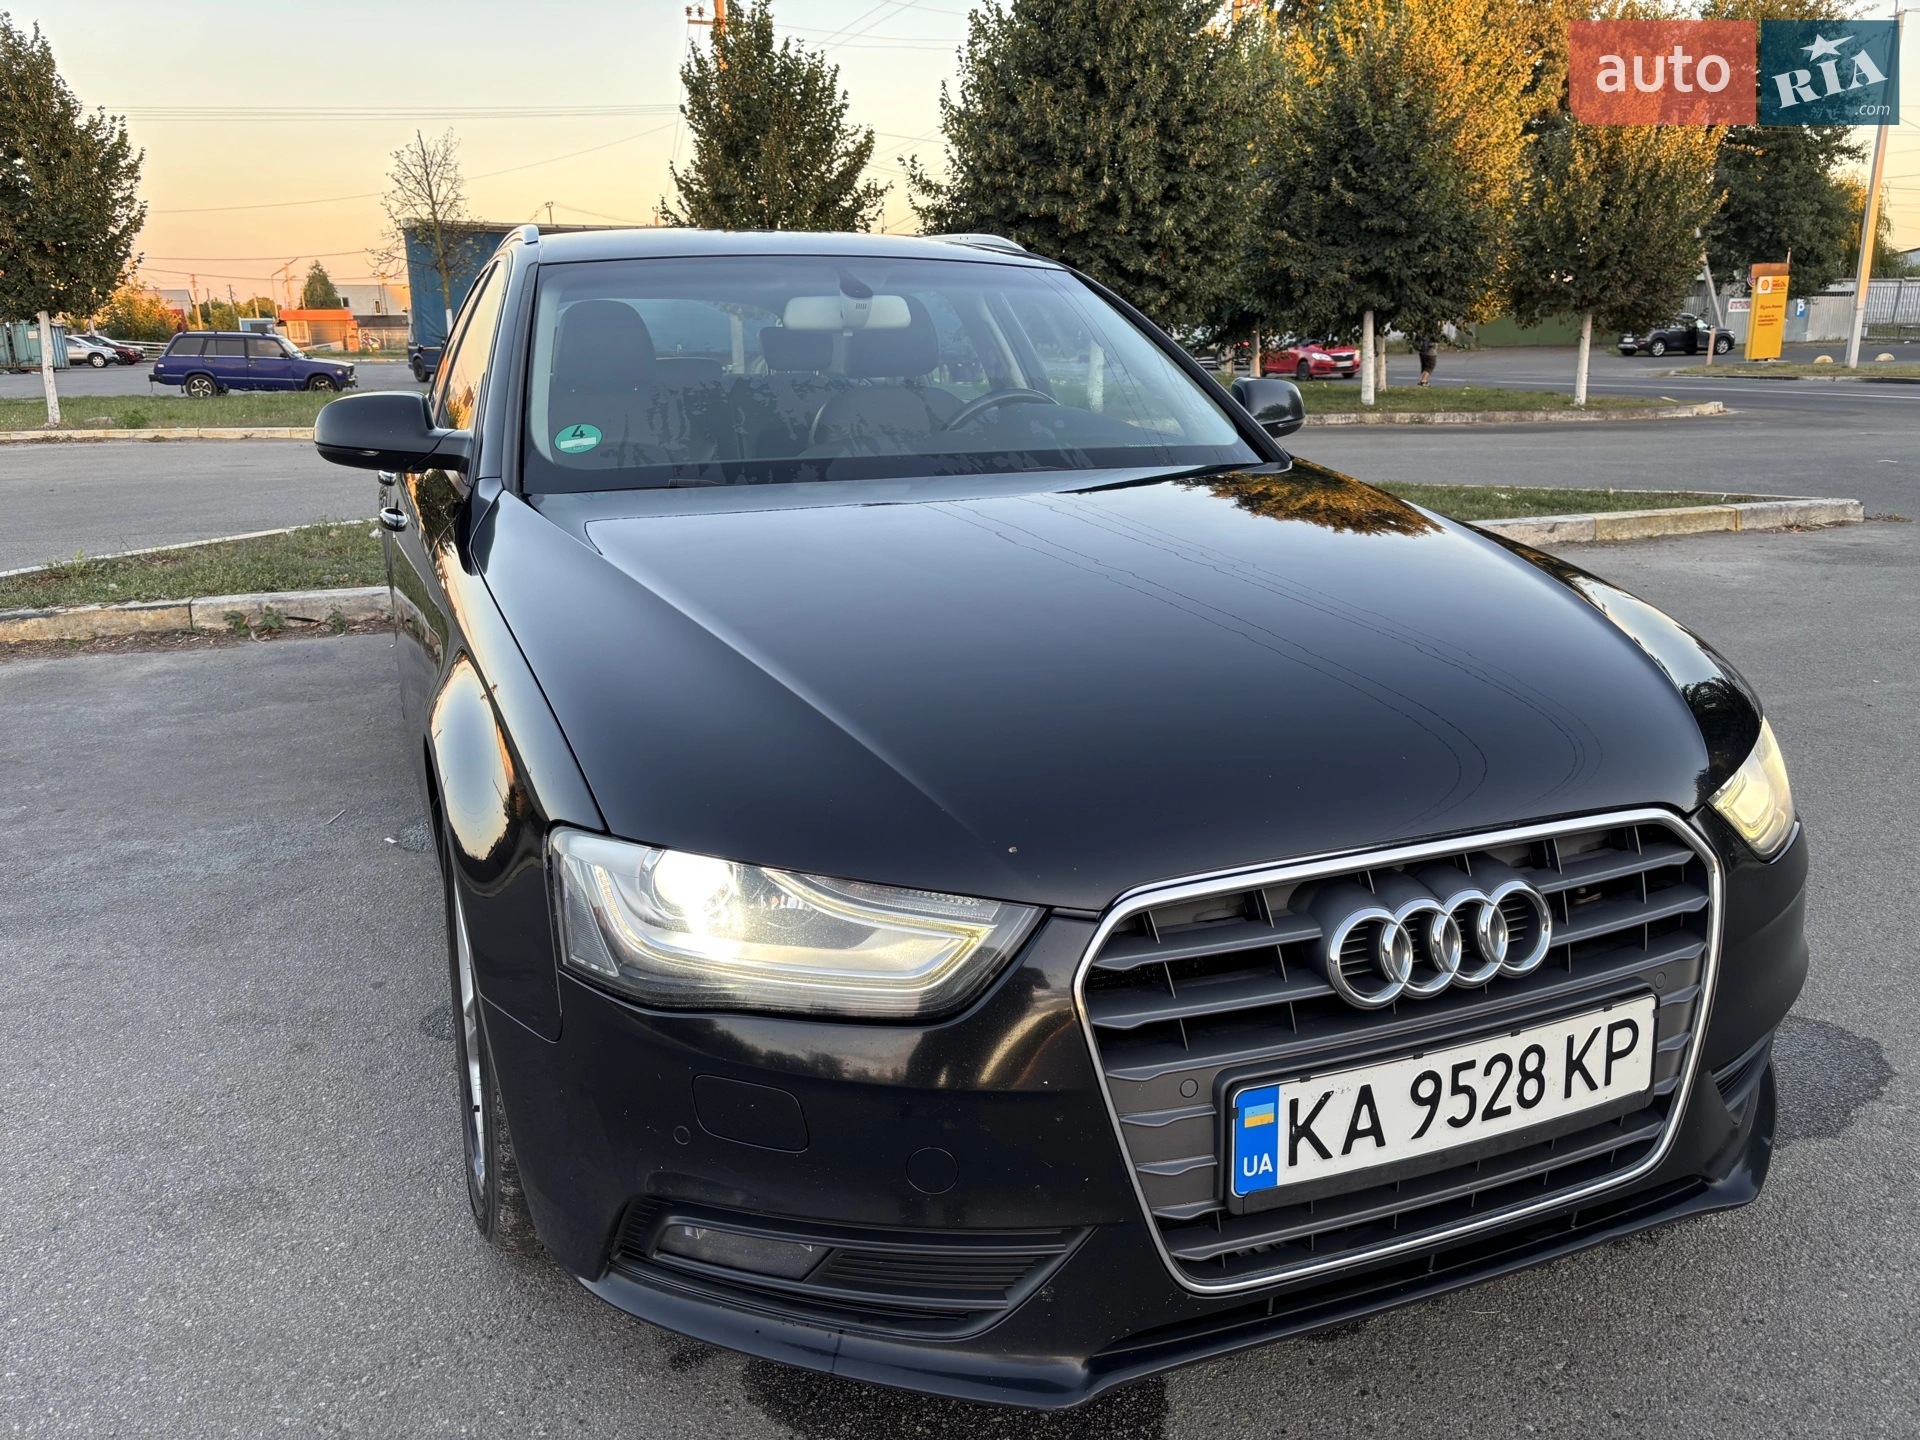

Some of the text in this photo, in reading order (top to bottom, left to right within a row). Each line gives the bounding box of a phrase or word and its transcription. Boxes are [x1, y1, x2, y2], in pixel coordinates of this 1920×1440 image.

[571, 425, 585, 438] 4
[1288, 1018, 1639, 1167] KA 9528 KP
[1243, 1154, 1273, 1177] UA
